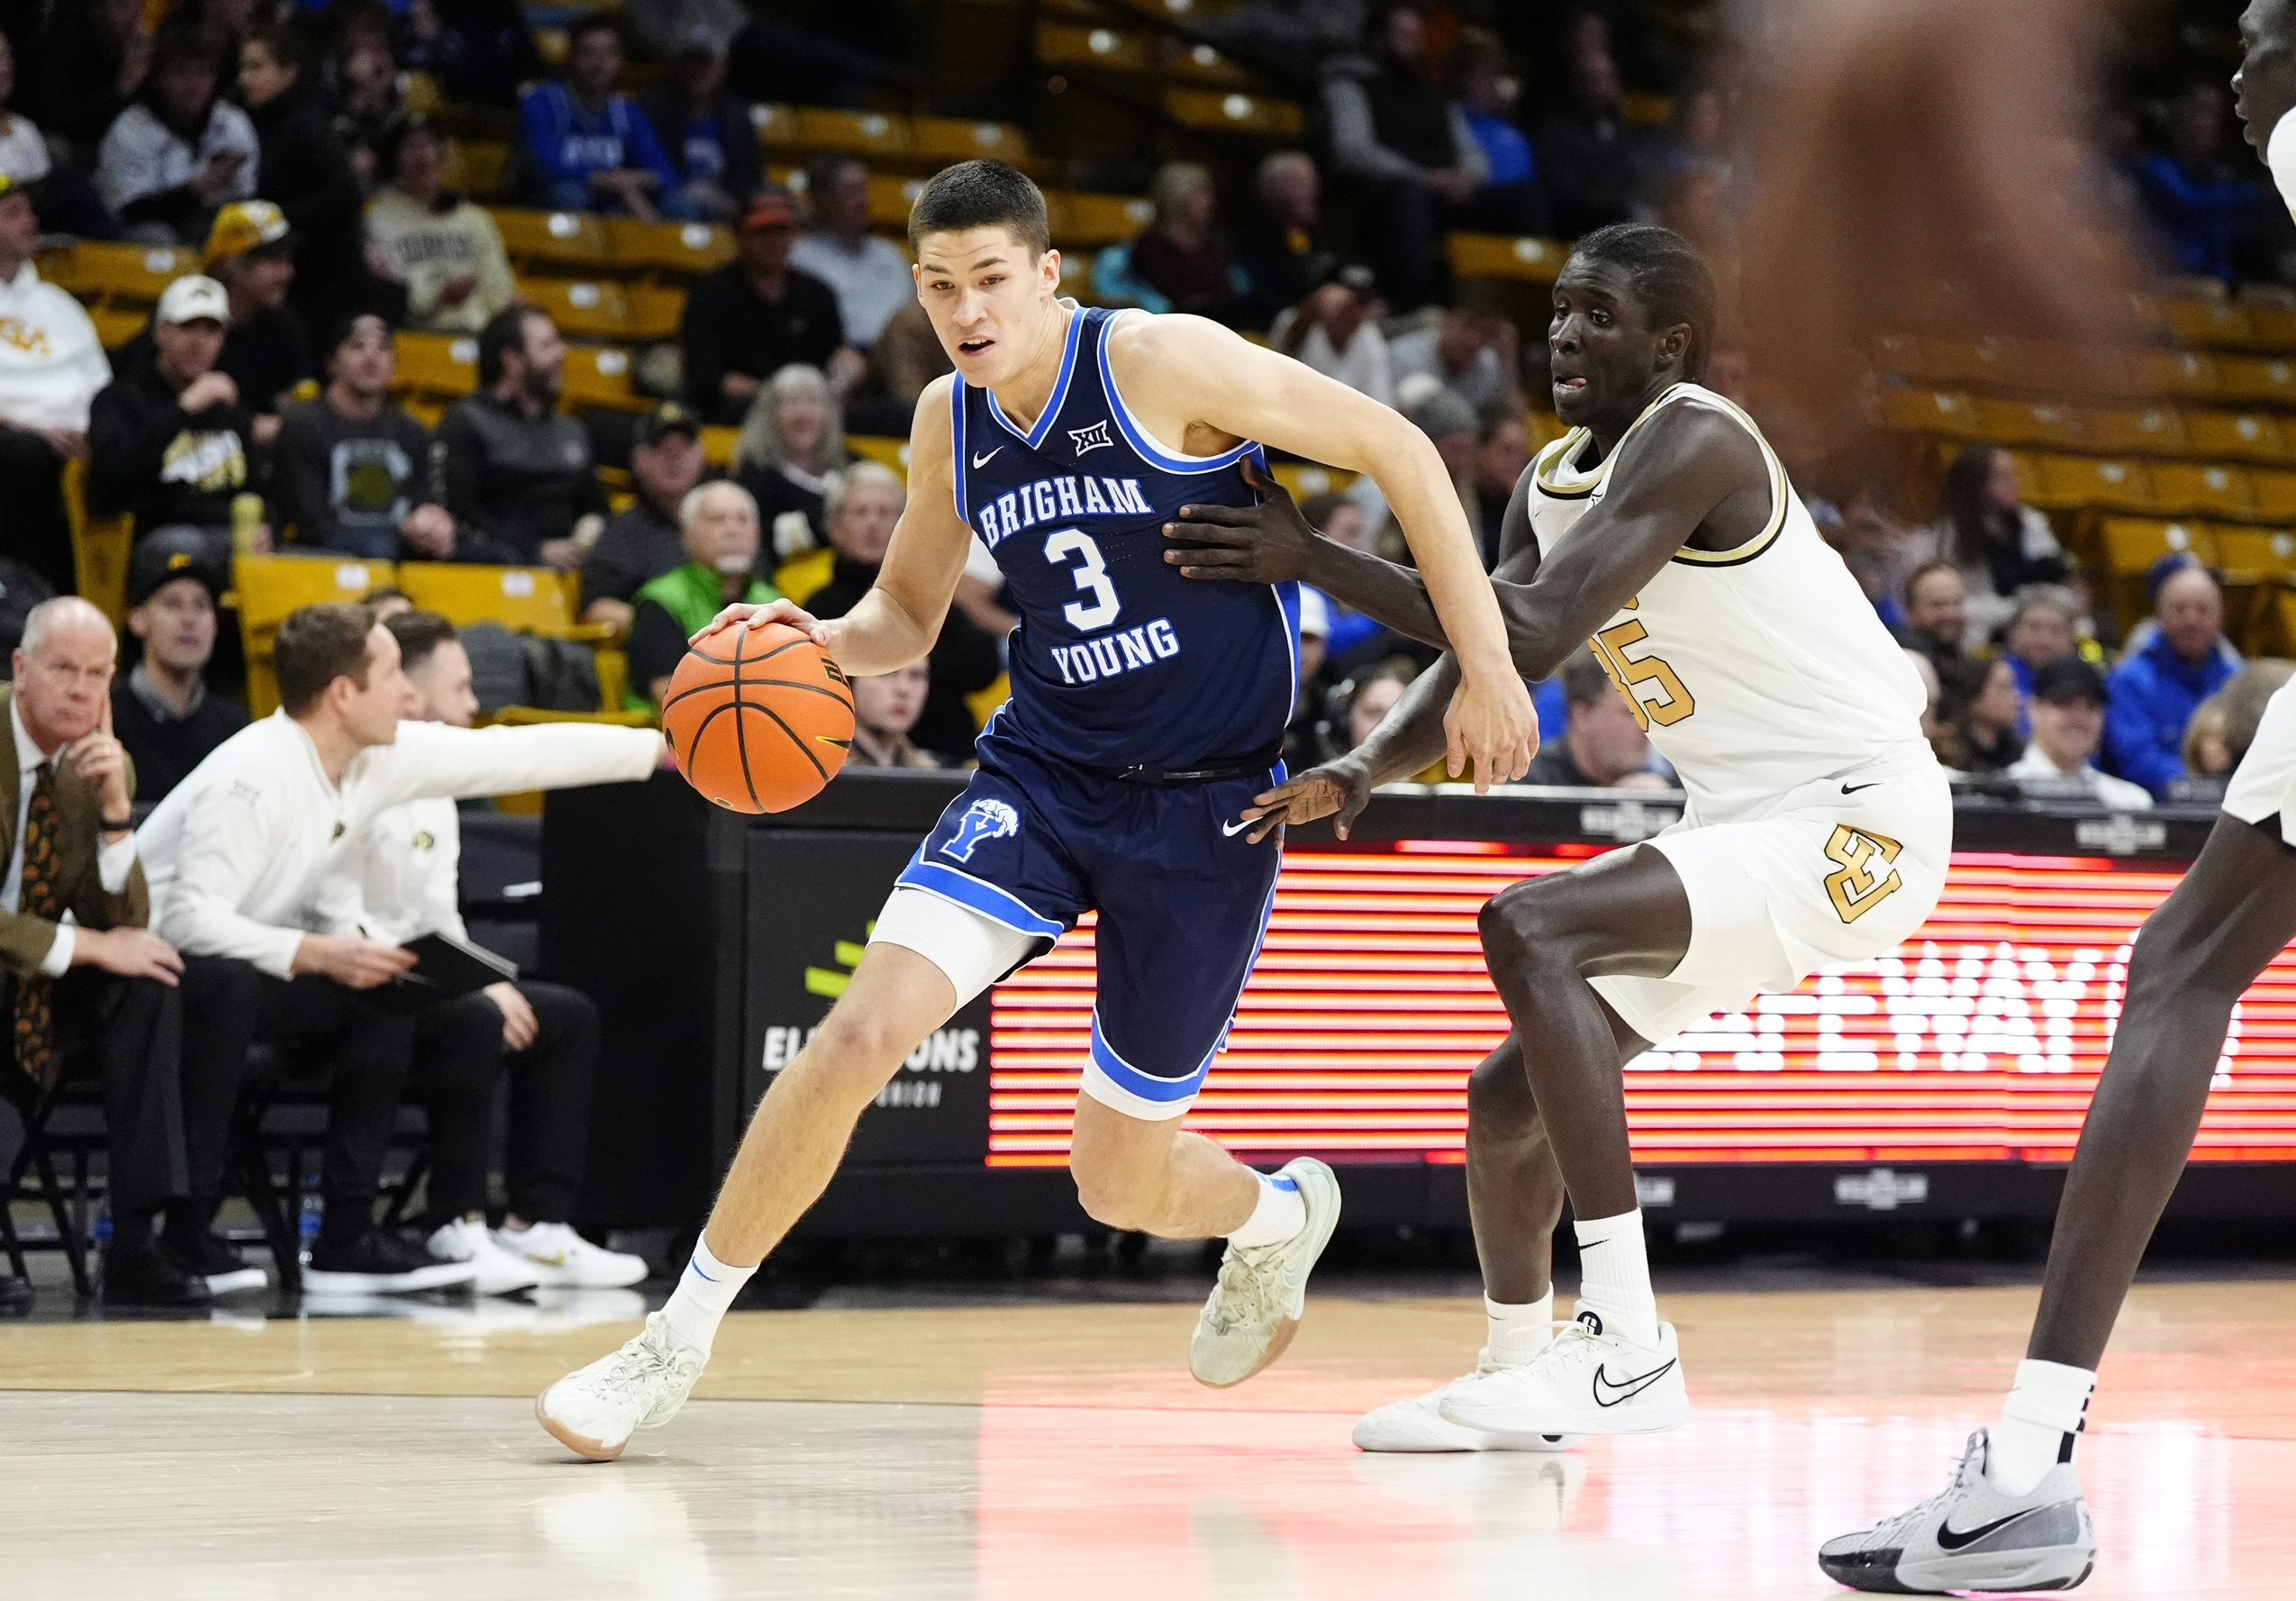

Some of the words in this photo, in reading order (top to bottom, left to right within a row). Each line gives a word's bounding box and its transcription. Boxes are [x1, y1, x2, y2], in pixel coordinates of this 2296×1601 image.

[978, 475, 1155, 551] BRIGHAM
[1042, 526, 1122, 632] 3
[1050, 617, 1180, 685] YOUNG
